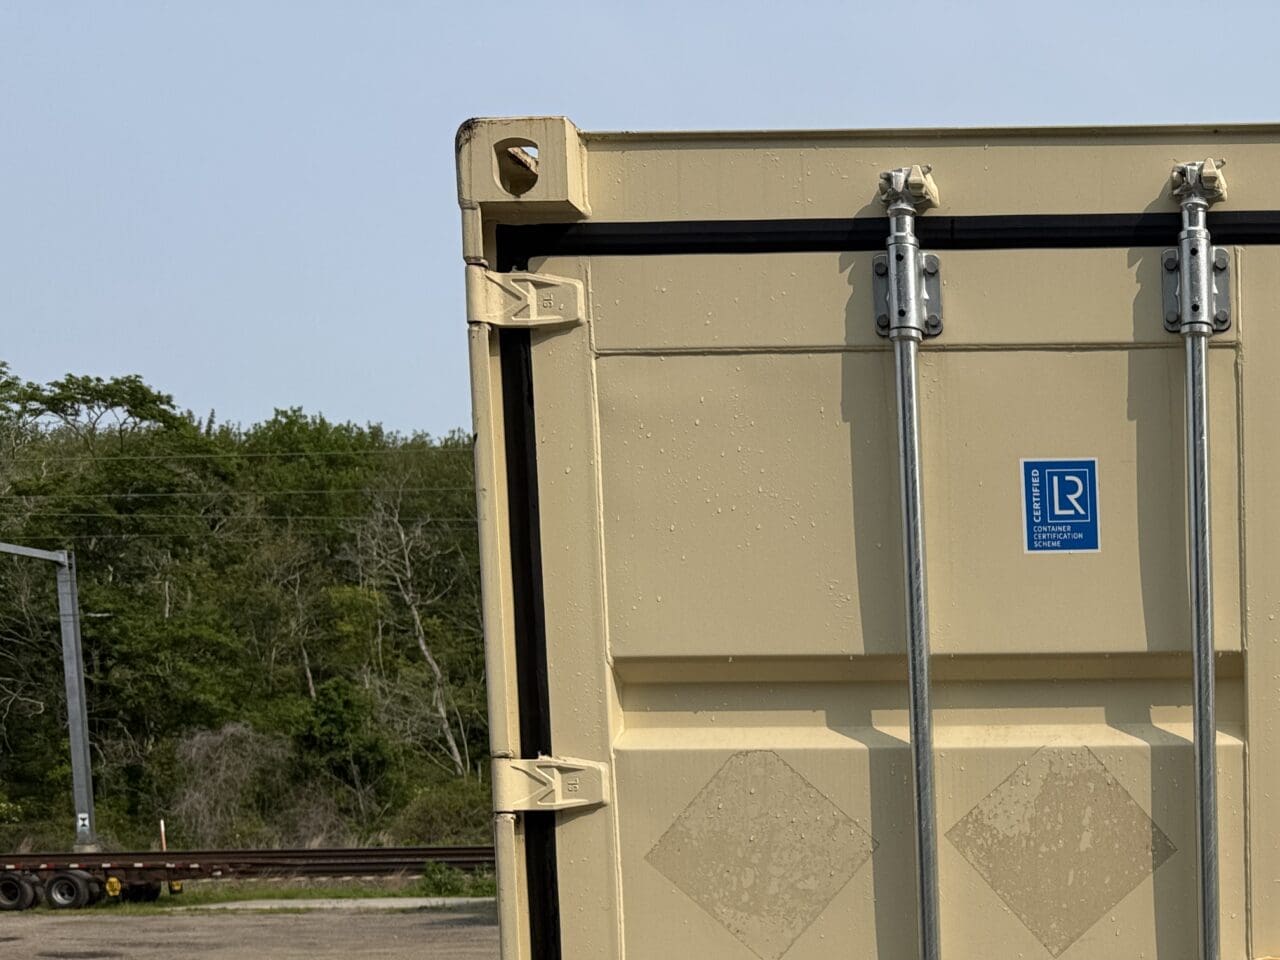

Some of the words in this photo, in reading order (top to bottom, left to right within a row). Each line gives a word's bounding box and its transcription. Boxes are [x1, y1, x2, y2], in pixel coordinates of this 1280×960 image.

[1032, 469, 1041, 522] CERTIFIED
[1052, 475, 1086, 515] LR
[1033, 532, 1084, 540] CERTIFICATION
[1034, 540, 1061, 548] SCHEME
